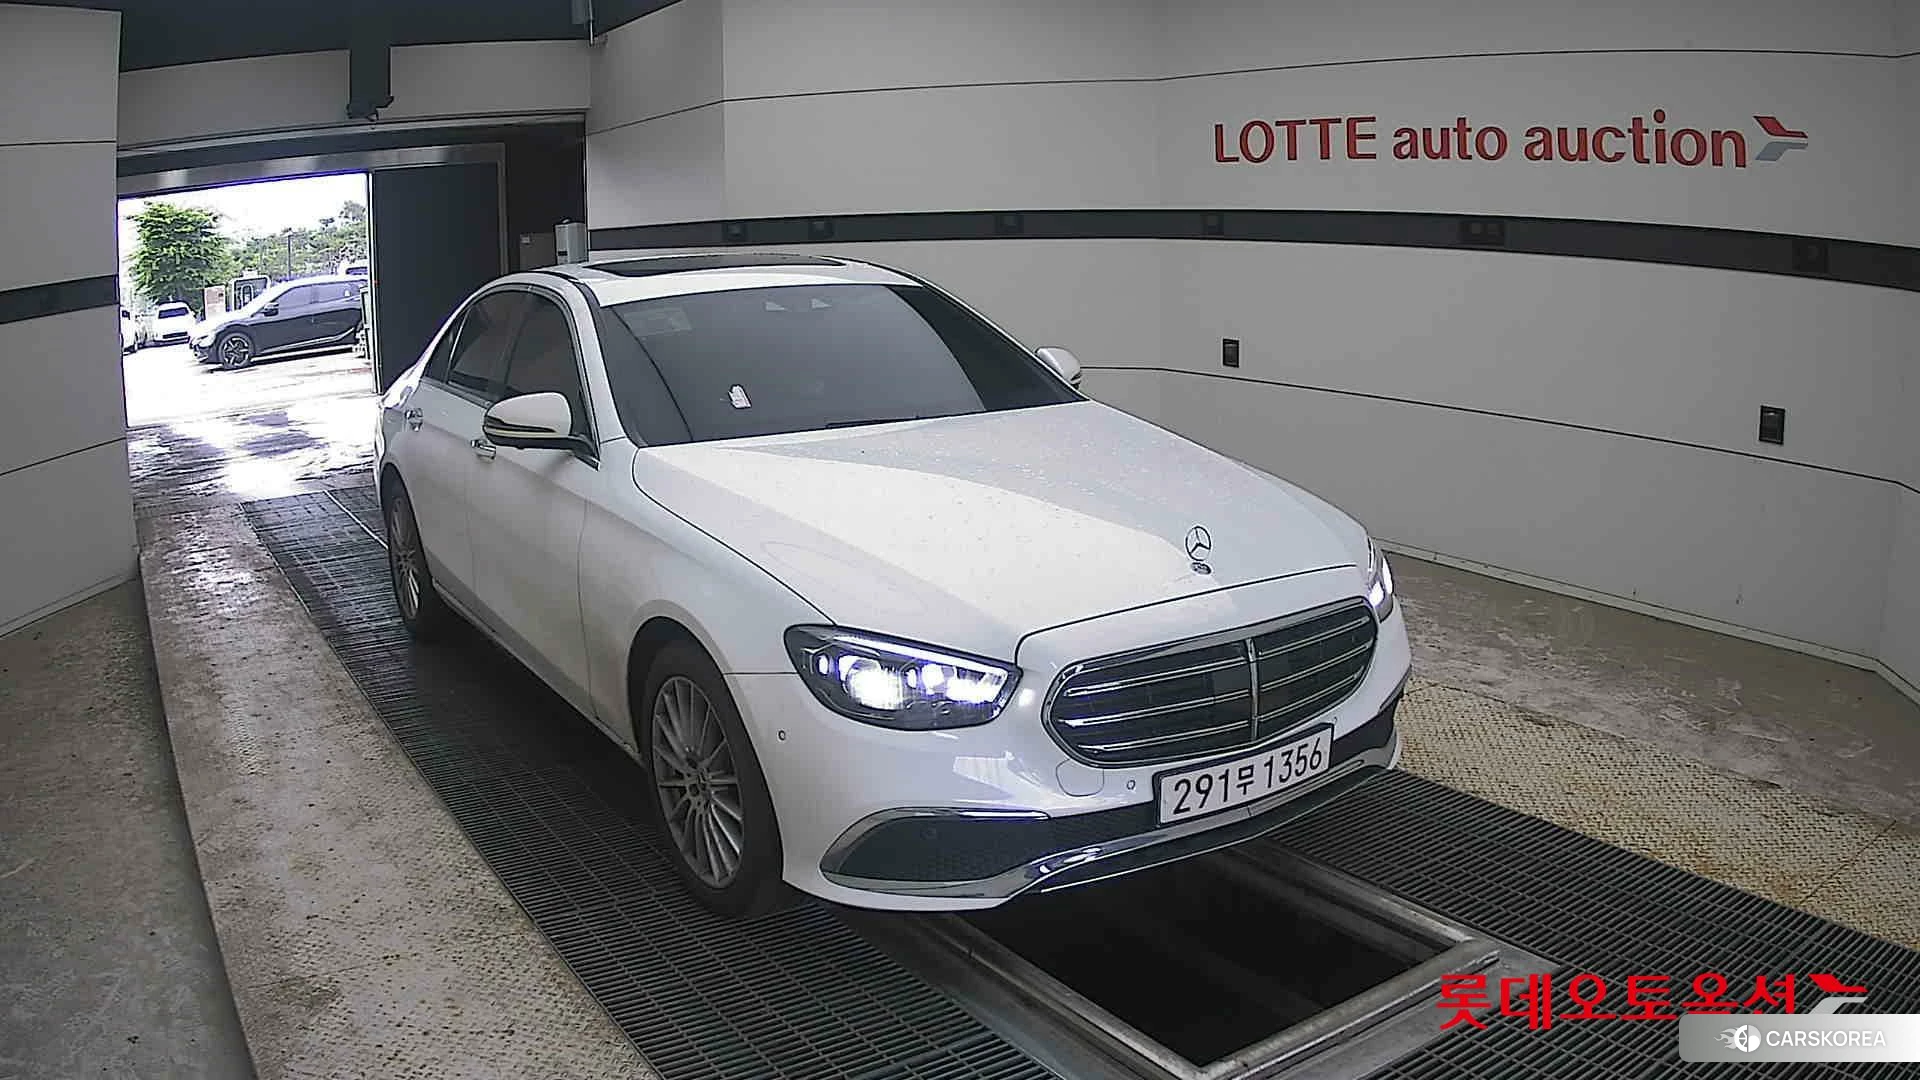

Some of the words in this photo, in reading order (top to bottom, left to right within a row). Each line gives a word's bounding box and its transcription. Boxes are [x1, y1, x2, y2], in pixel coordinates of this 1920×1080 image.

[1214, 115, 1378, 164] LOTTE
[1392, 116, 1508, 161] auto
[1523, 109, 1748, 169] auction
[1172, 764, 1255, 815] 291무
[1263, 737, 1323, 789] 1356
